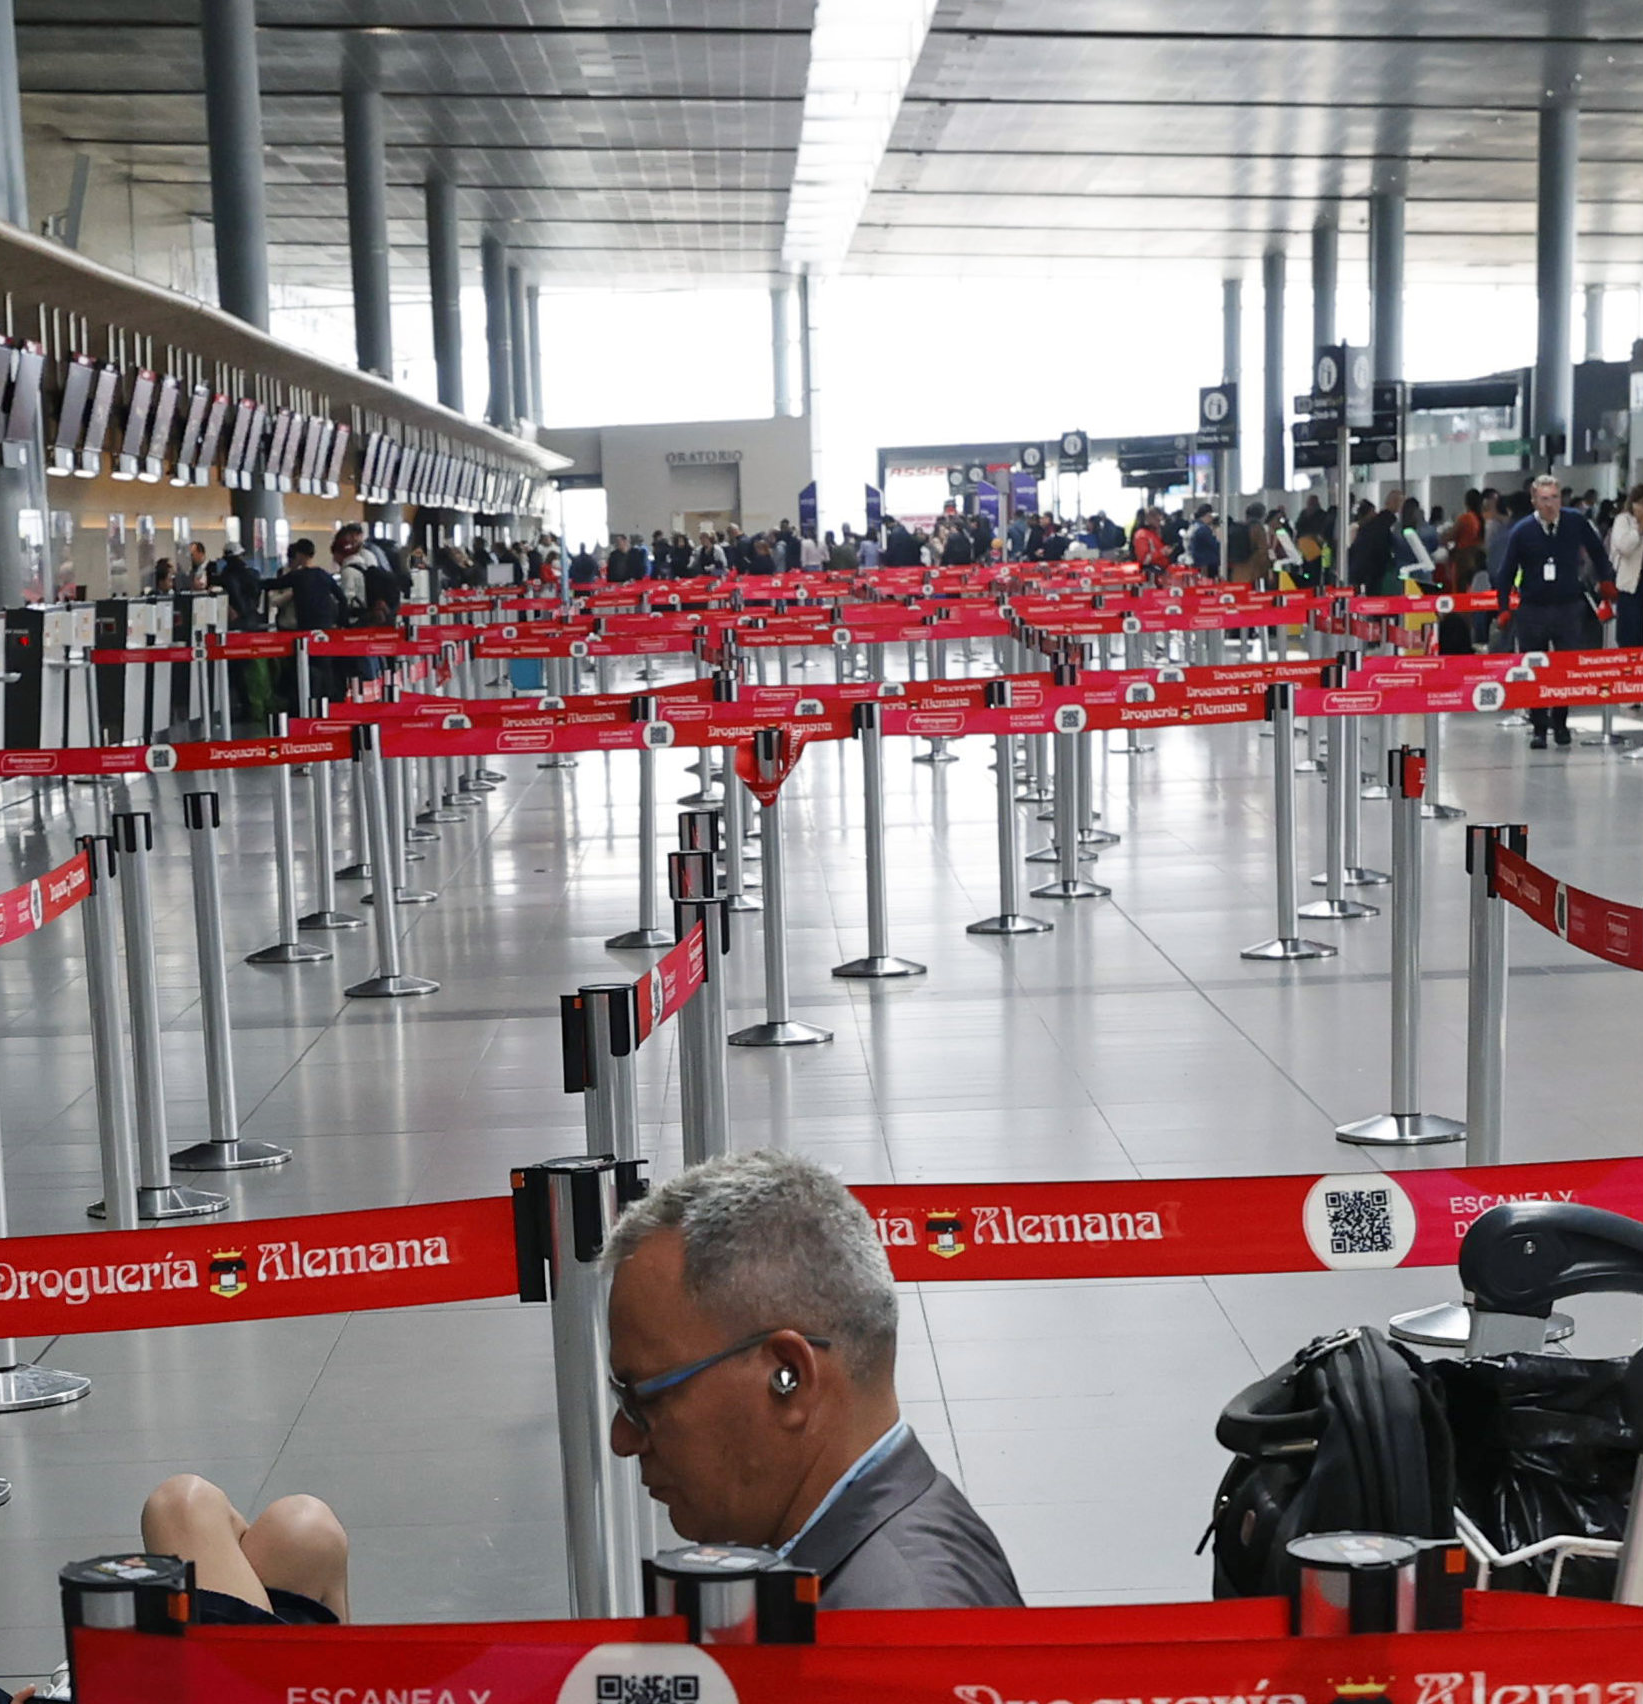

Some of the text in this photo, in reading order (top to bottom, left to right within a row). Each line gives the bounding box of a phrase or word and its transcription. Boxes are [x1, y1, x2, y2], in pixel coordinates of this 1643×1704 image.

[666, 451, 743, 464] ORATORIO
[972, 1207, 1162, 1244] Alemana
[258, 1237, 449, 1281] Alemana
